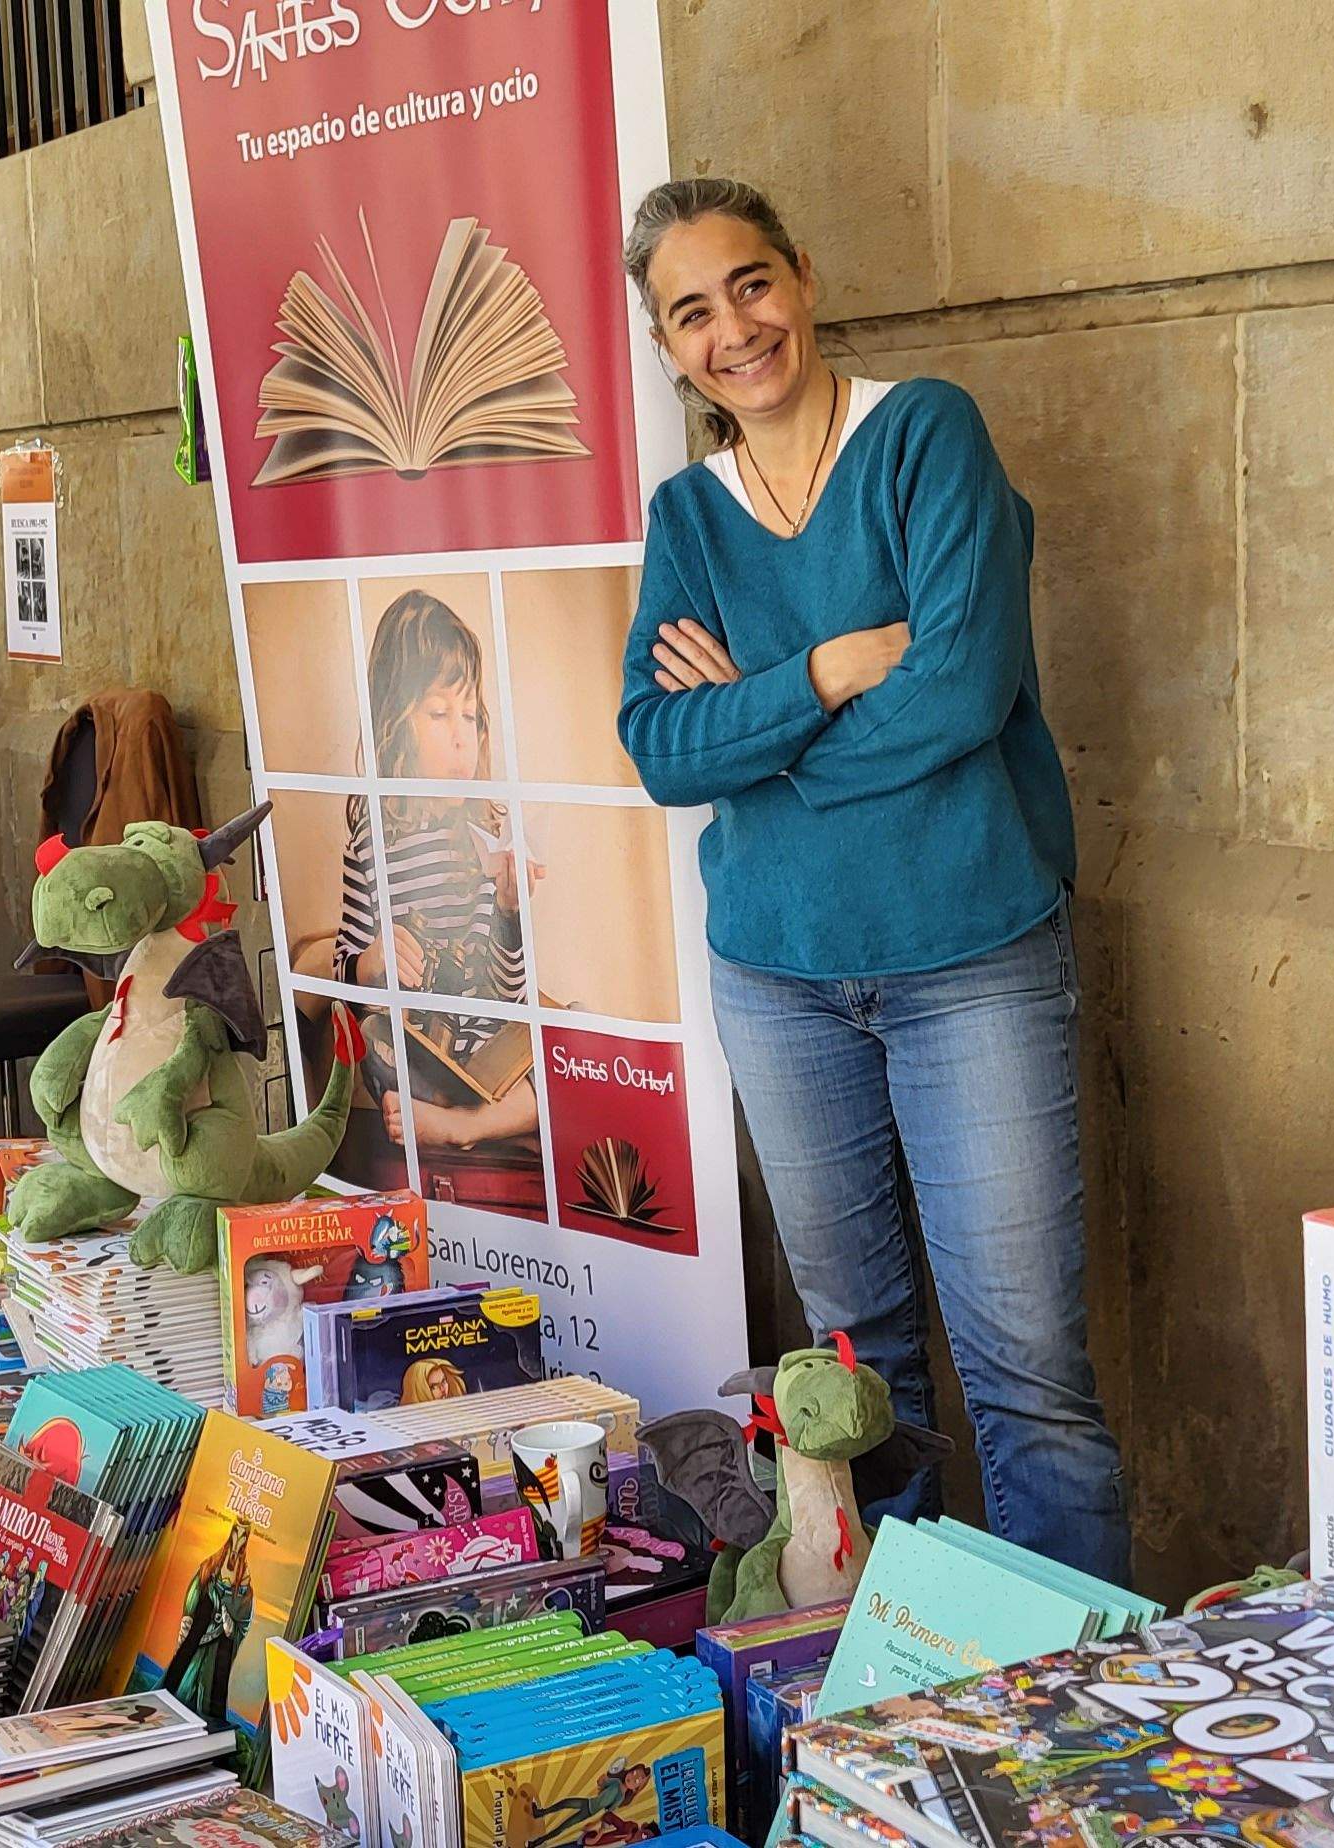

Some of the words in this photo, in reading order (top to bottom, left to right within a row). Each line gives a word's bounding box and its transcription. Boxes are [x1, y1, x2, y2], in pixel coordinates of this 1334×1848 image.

[192, 0, 360, 88] SANTOS
[237, 133, 264, 162] Tu
[267, 113, 345, 159] espacio
[350, 104, 380, 138] de
[384, 89, 465, 131] cultura
[469, 83, 485, 120] y
[490, 67, 539, 107] ocio
[552, 1046, 608, 1082] SANTOS
[614, 1056, 675, 1095] OCHOA
[253, 1236, 272, 1249] QUE
[273, 1233, 298, 1246] VINO
[300, 1234, 308, 1243] A
[309, 1226, 354, 1244] CENAR
[265, 1222, 279, 1234] LA
[280, 1213, 340, 1233] OVEJITA
[427, 1228, 465, 1266] San
[474, 1237, 576, 1297] Lorenzo,
[583, 1264, 594, 1295] 1
[1322, 1274, 1331, 1326] HUMO
[405, 1318, 487, 1340] CAPITANA
[406, 1331, 489, 1355] MARVEL
[570, 1315, 600, 1351] 12
[1323, 1334, 1333, 1356] DE
[1324, 1367, 1334, 1457] CIUDADES
[229, 1449, 286, 1498] Campana
[227, 1479, 272, 1529] Huesca
[31, 1516, 50, 1547] II
[867, 1592, 893, 1623] Mi
[892, 1605, 957, 1656] Primera
[884, 1639, 923, 1669] Recuerdos,
[890, 1664, 910, 1679] para
[911, 1671, 921, 1683] el
[315, 1688, 328, 1713] EL
[314, 1721, 355, 1767] FUERTE
[386, 1730, 396, 1753] EL
[386, 1756, 416, 1818] FUERTE
[660, 1762, 679, 1787] EL
[494, 1790, 505, 1834] Manual
[662, 1787, 683, 1830] MIST
